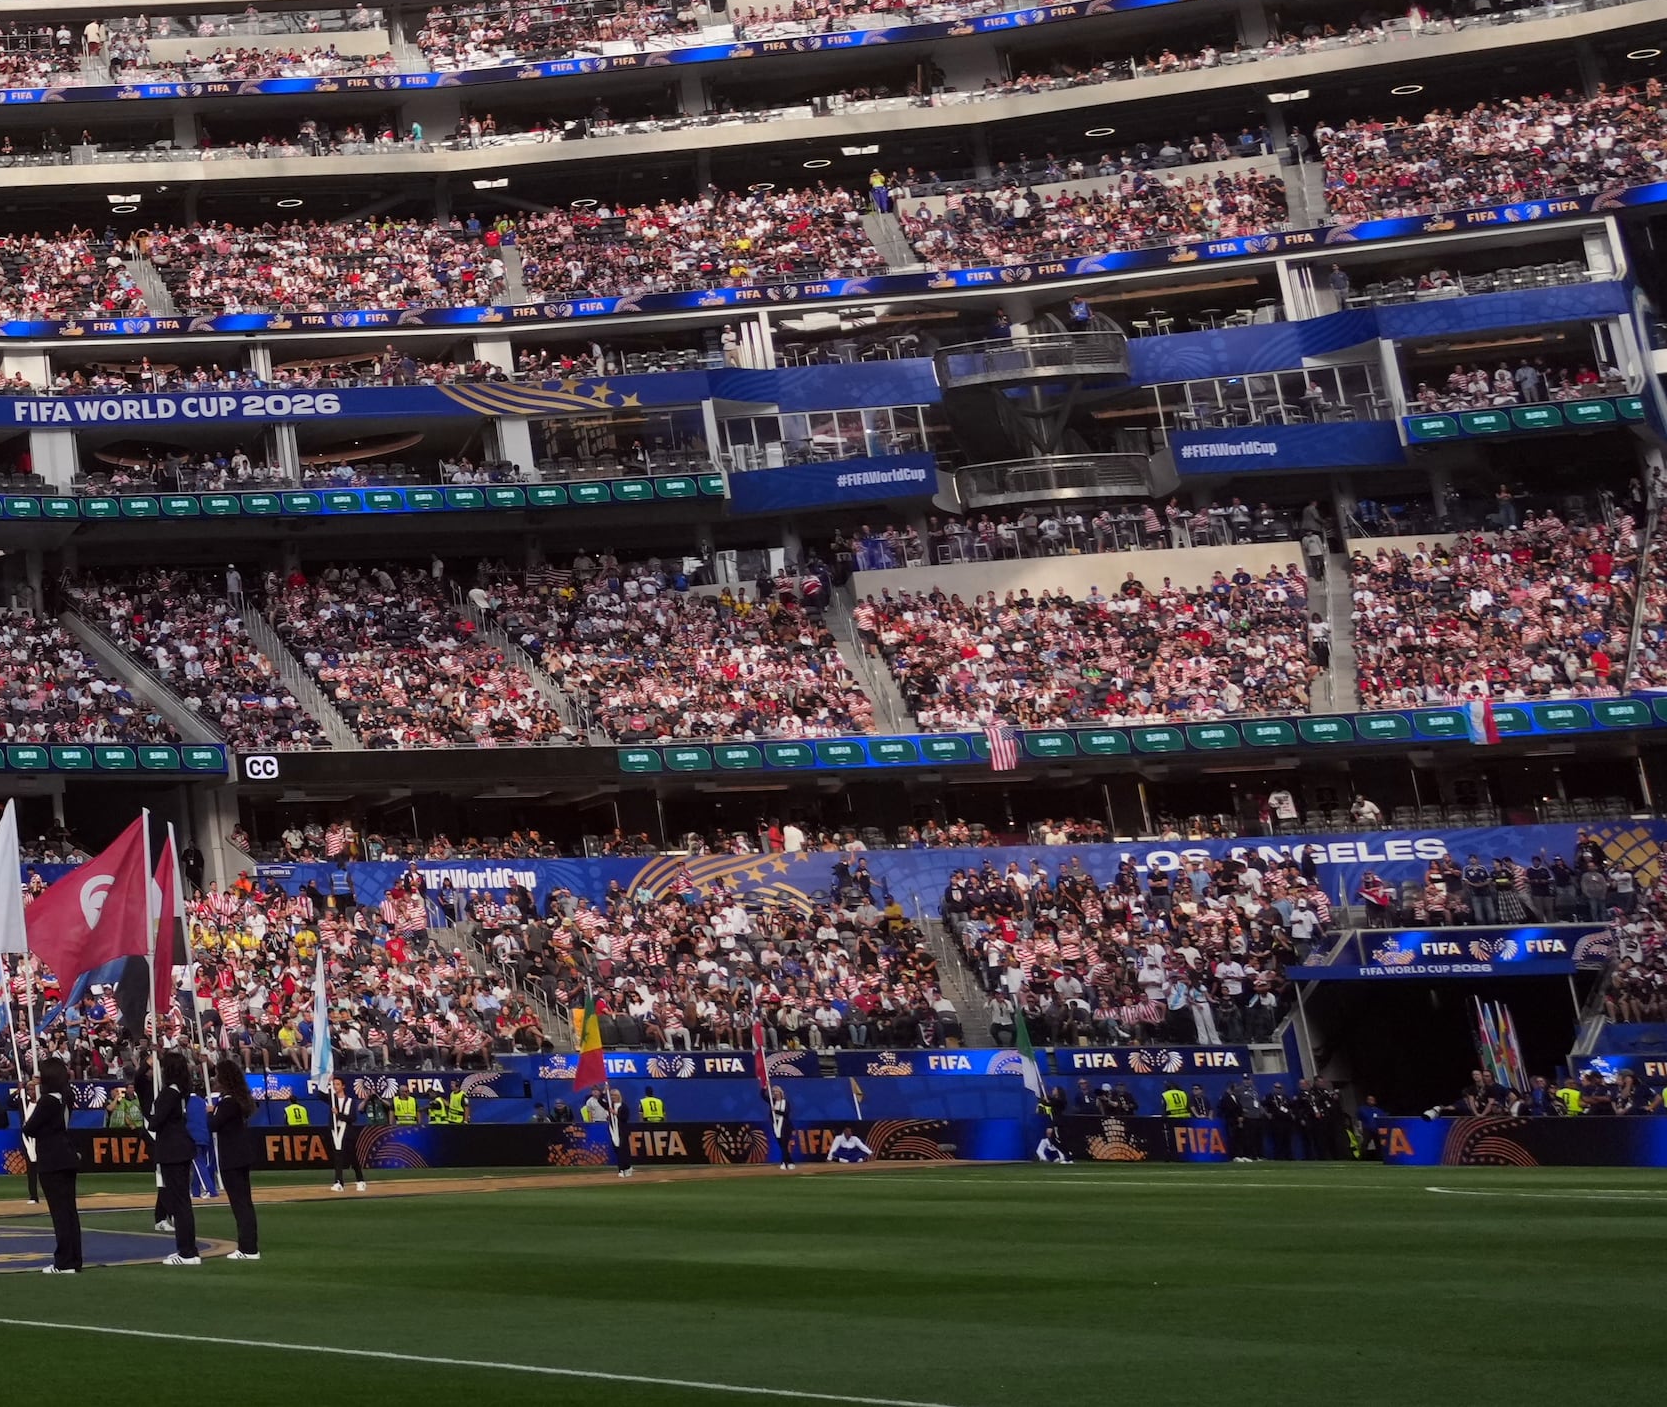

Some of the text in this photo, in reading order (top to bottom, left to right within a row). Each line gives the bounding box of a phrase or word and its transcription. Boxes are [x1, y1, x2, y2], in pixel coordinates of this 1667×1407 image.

[1051, 6, 1076, 16] FIFA
[984, 17, 1009, 27] FIFA
[828, 35, 852, 44] FIFA
[763, 42, 787, 51] FIFA
[613, 57, 636, 65] FIFA
[551, 63, 574, 72] FIFA
[347, 79, 369, 87] FIFA
[406, 76, 428, 84] FIFA
[149, 86, 171, 94] FIFA
[208, 84, 229, 92] FIFA
[11, 91, 33, 99] FIFA
[1548, 201, 1579, 212] FIFA
[1467, 211, 1497, 222] FIFA
[1285, 233, 1314, 244] FIFA
[1208, 243, 1237, 254] FIFA
[1038, 264, 1065, 274] FIFA
[967, 272, 994, 281] FIFA
[736, 290, 761, 299] FIFA
[804, 285, 830, 294] FIFA
[513, 307, 538, 316] FIFA
[579, 302, 604, 311] FIFA
[302, 316, 325, 324] FIFA
[365, 314, 389, 322] FIFA
[94, 322, 117, 331] FIFA
[156, 321, 179, 329] FIFA
[14, 394, 341, 422] FIFA WORLD CUP 2026
[1180, 441, 1278, 459] #FIFAWorldCup
[836, 467, 926, 488] #FIFAWorldCup
[249, 760, 275, 776] CC
[1421, 942, 1461, 955] FIFA
[1525, 939, 1566, 952] FIFA
[1359, 964, 1492, 975] FIFA WORLD CUP 2026
[929, 1056, 971, 1069] FIFA
[1073, 1053, 1117, 1068] FIFA
[1194, 1052, 1239, 1066] FIFA
[705, 1058, 745, 1072] FIFA
[407, 1079, 444, 1093] FIFA
[629, 1131, 687, 1156] FIFA
[1174, 1127, 1226, 1153] FIFA
[266, 1135, 328, 1161] FIFA
